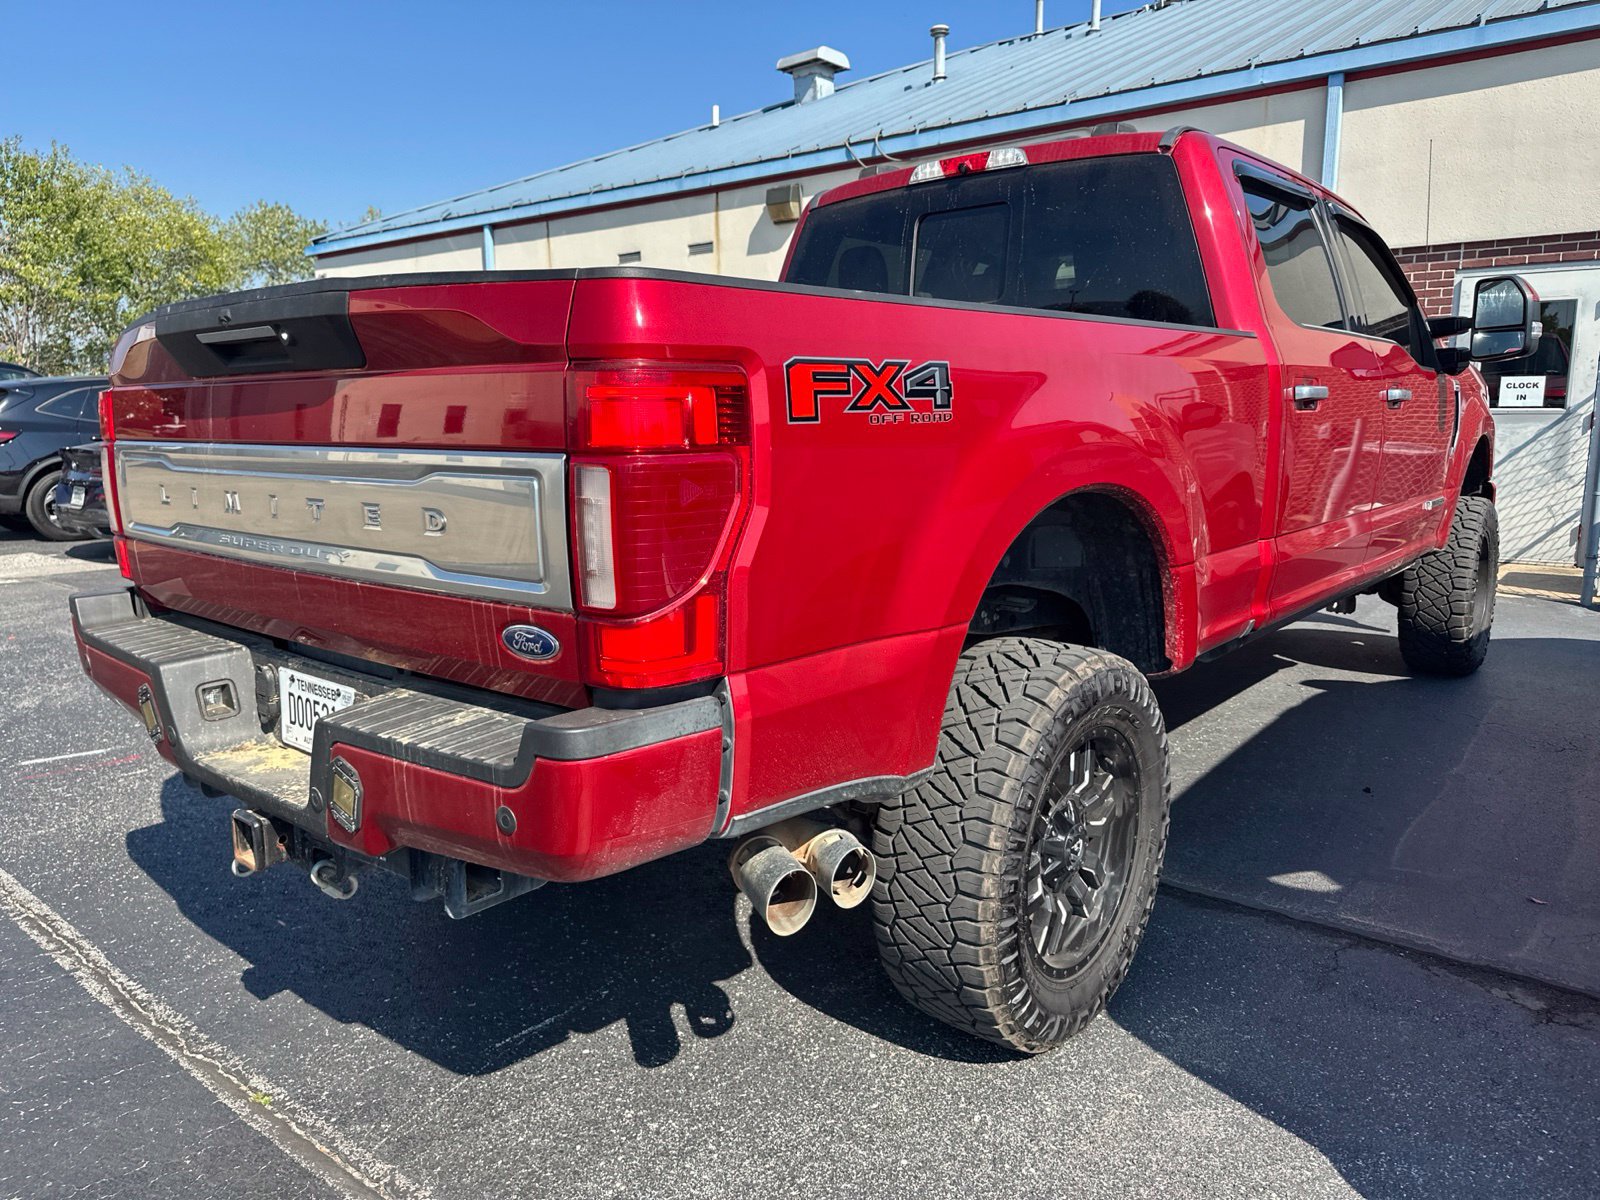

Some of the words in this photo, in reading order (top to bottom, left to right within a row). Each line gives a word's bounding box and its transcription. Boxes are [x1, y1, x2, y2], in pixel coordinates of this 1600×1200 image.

[783, 356, 953, 424] FX4
[869, 412, 904, 425] OFF
[910, 411, 953, 424] ROAD
[159, 484, 447, 537] LIMITED
[219, 533, 284, 553] SUPER
[289, 544, 350, 563] DUTY
[512, 631, 543, 654] Ford
